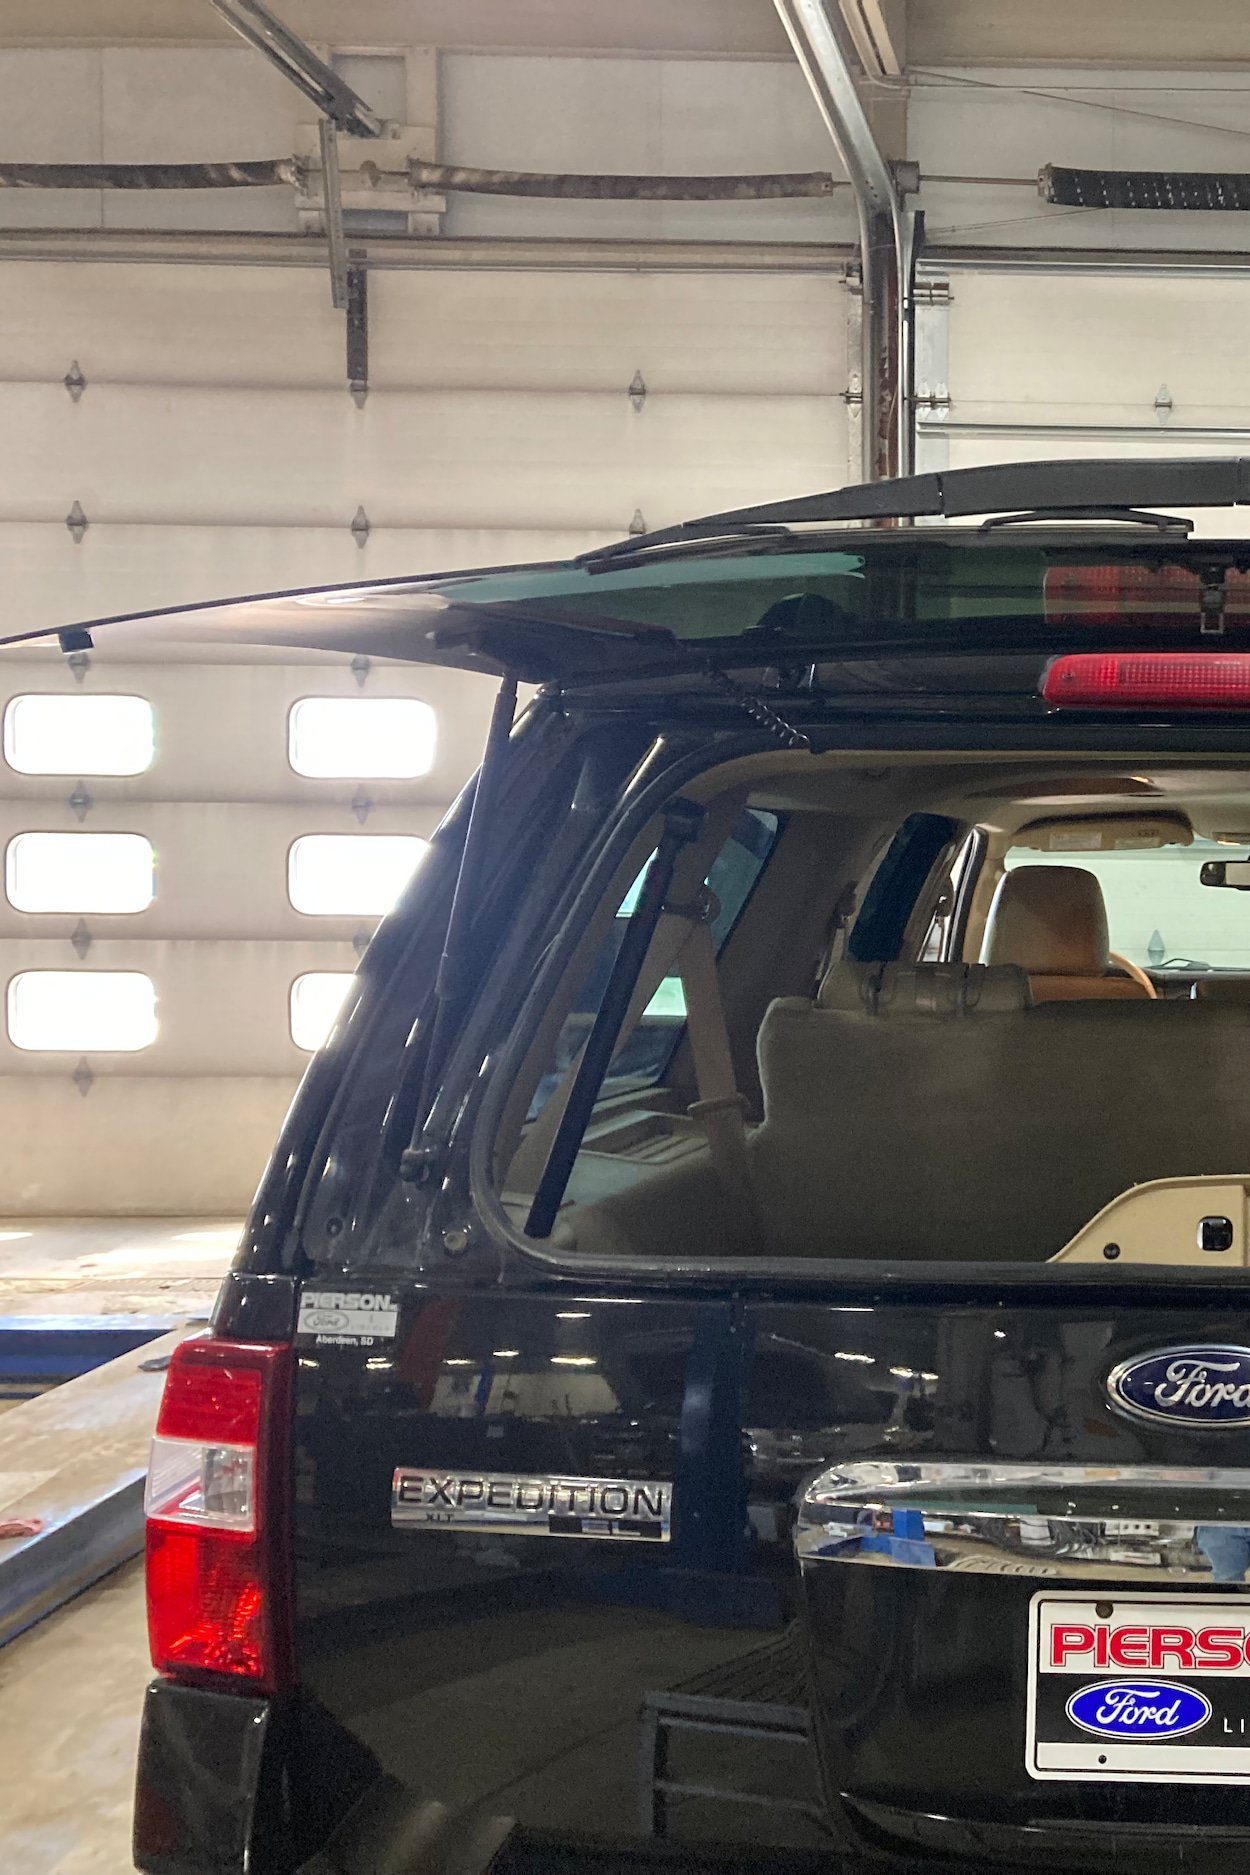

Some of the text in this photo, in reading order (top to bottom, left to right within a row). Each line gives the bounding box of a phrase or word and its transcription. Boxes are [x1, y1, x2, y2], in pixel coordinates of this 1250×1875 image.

[300, 1292, 391, 1310] PIERSON
[361, 1336, 374, 1346] SD
[399, 1475, 662, 1516] EXPEDITION
[425, 1513, 452, 1523] XLT
[1096, 1688, 1182, 1726] Ford
